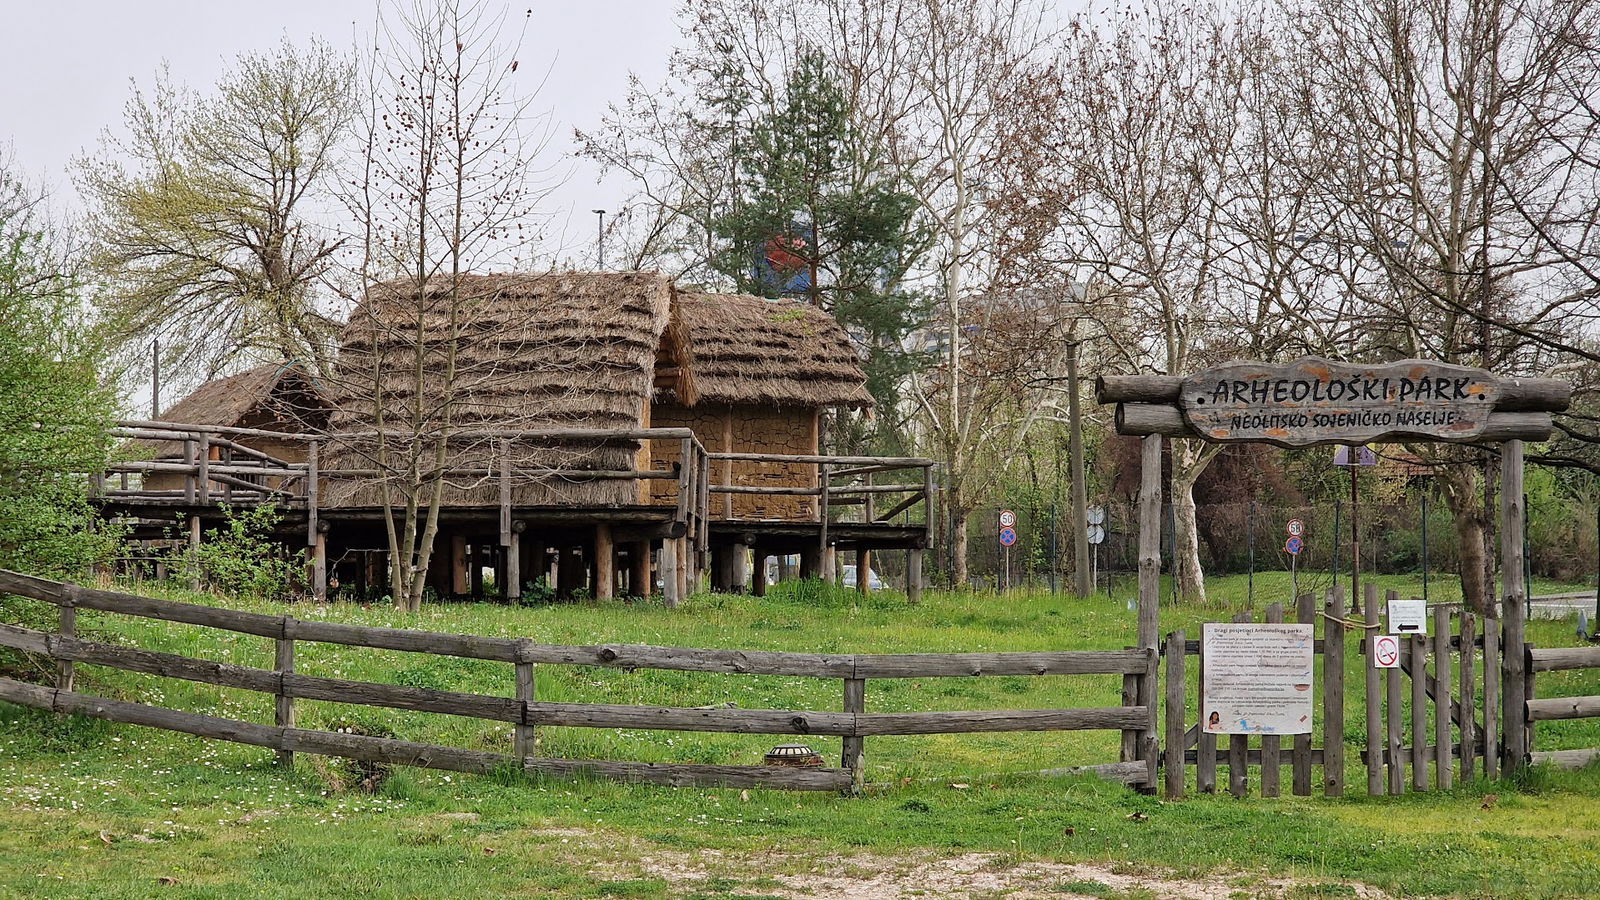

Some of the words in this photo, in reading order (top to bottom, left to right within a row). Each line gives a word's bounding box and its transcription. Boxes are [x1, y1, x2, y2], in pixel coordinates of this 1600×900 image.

[1209, 375, 1389, 404] ARHEOLOŠKI
[1400, 376, 1470, 402] PARK
[1231, 414, 1308, 430] NEOLITSKO
[1313, 410, 1391, 428] SOJENIČKO
[1396, 411, 1455, 426] NASELJE
[1002, 514, 1013, 524] 50
